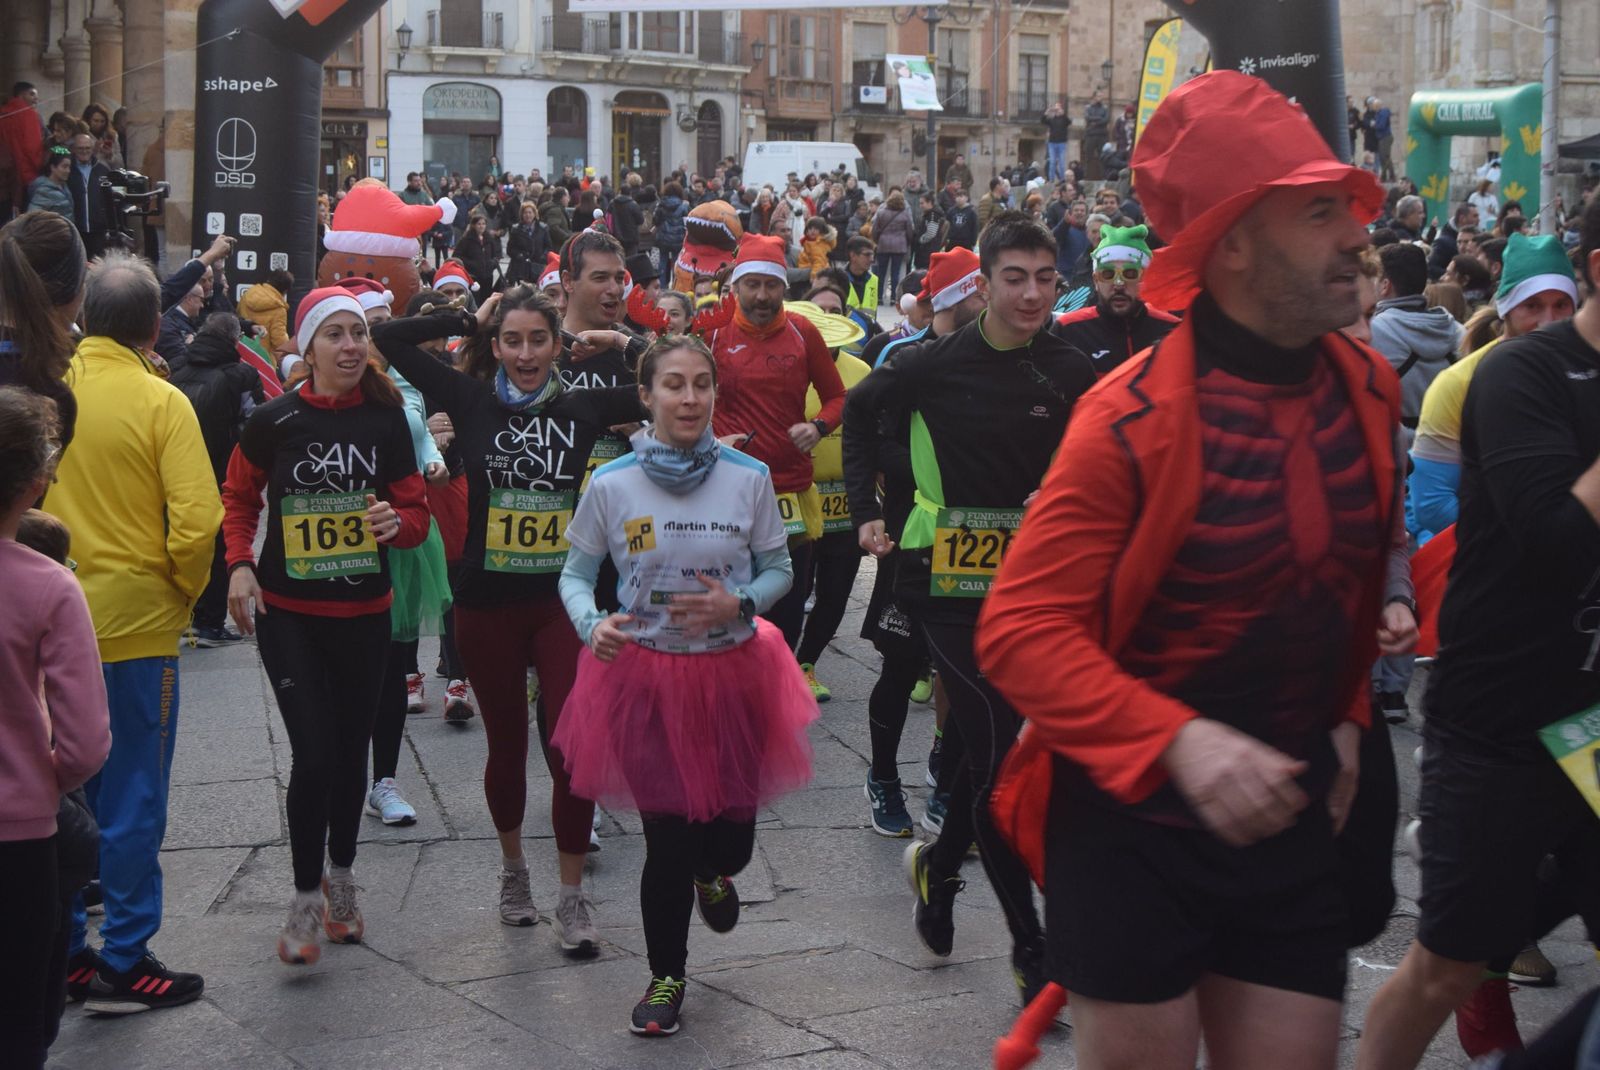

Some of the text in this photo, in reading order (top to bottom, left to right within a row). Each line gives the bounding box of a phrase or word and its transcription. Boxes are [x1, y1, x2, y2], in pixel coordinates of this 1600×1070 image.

[1260, 52, 1316, 69] invisalign
[432, 87, 488, 99] ORTOPEDIA
[432, 99, 489, 110] ZAMORANA
[1437, 102, 1495, 121] CAJA RURAL
[215, 171, 256, 185] DSD
[494, 415, 575, 454] SAN
[292, 441, 377, 486] SAN
[513, 442, 575, 481] SIL
[310, 494, 364, 505] FUNDACION
[310, 502, 365, 513] CAJA RURAL
[515, 502, 563, 511] CAJA RURAL
[966, 512, 1024, 521] FUNDACION
[498, 513, 560, 548] 164
[966, 520, 989, 529] CAJA
[294, 515, 365, 552] 163
[313, 557, 376, 573] CAJA RURAL
[510, 556, 565, 567] CAJA RURAL
[959, 581, 985, 591] CAJA
[889, 617, 904, 627] BAR
